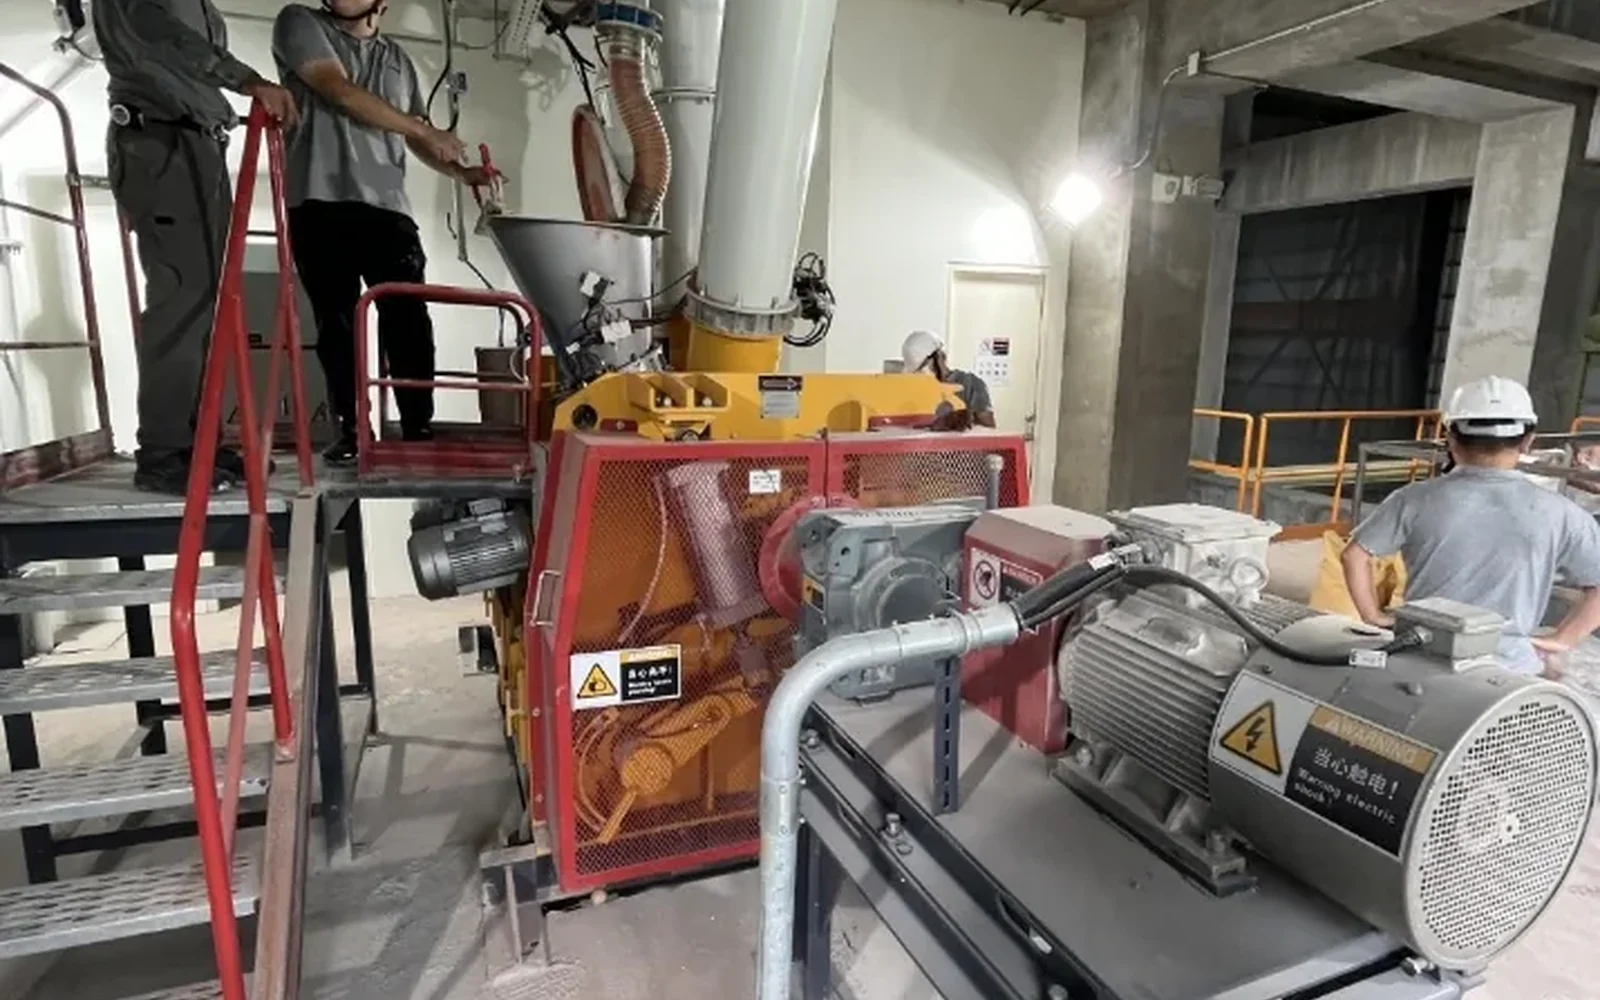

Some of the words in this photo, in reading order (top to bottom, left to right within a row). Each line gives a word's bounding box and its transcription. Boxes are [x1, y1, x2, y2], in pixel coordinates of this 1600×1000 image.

[1313, 747, 1399, 800] 当心触电!
[1345, 793, 1396, 825] electric
